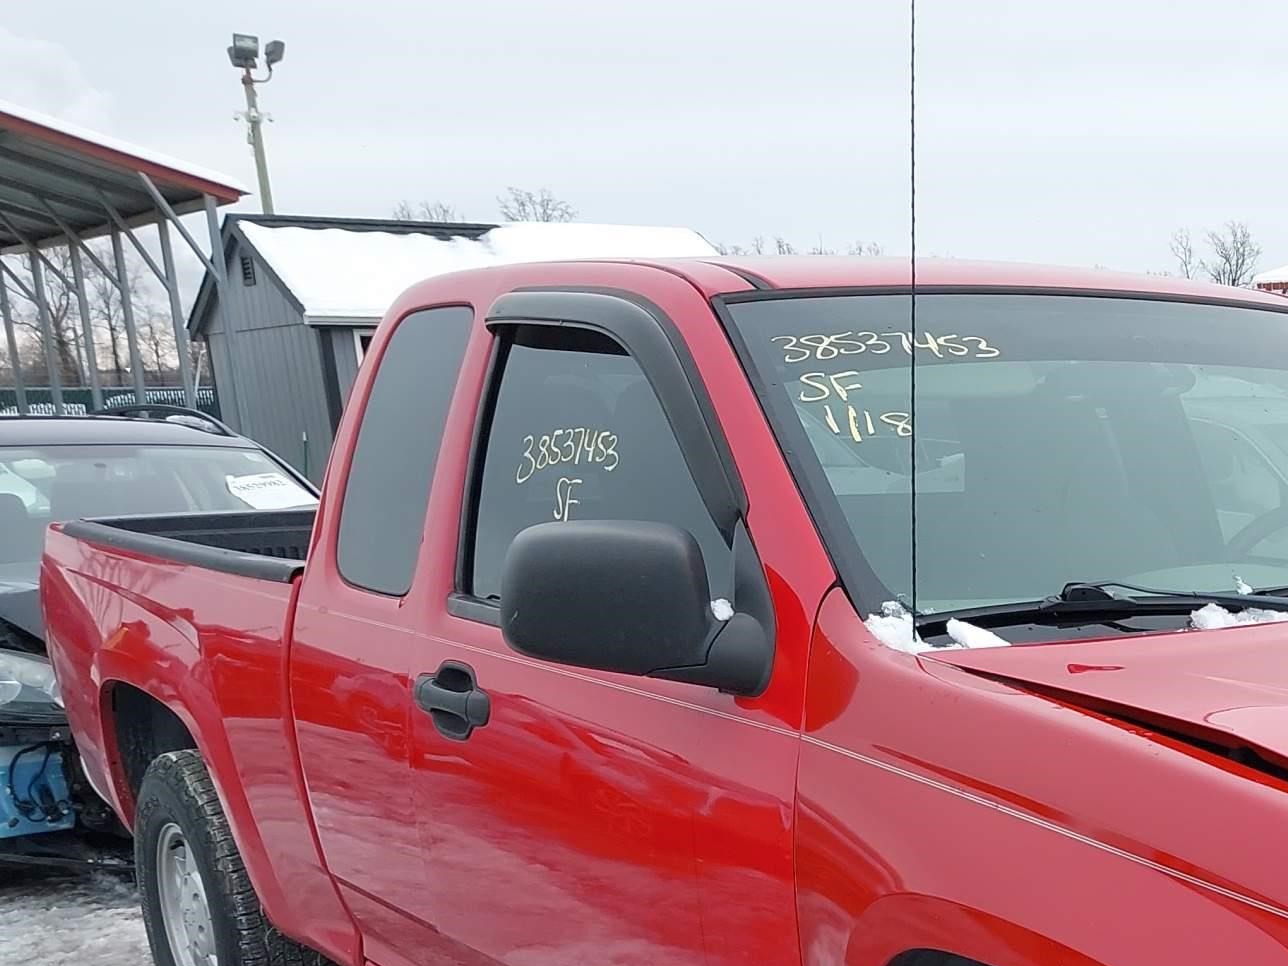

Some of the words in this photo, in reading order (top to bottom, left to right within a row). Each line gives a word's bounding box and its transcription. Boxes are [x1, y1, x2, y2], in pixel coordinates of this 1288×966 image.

[771, 331, 1000, 363] 38537453
[799, 371, 863, 402] SF
[516, 427, 619, 483] 38537453
[553, 477, 583, 522] SF
